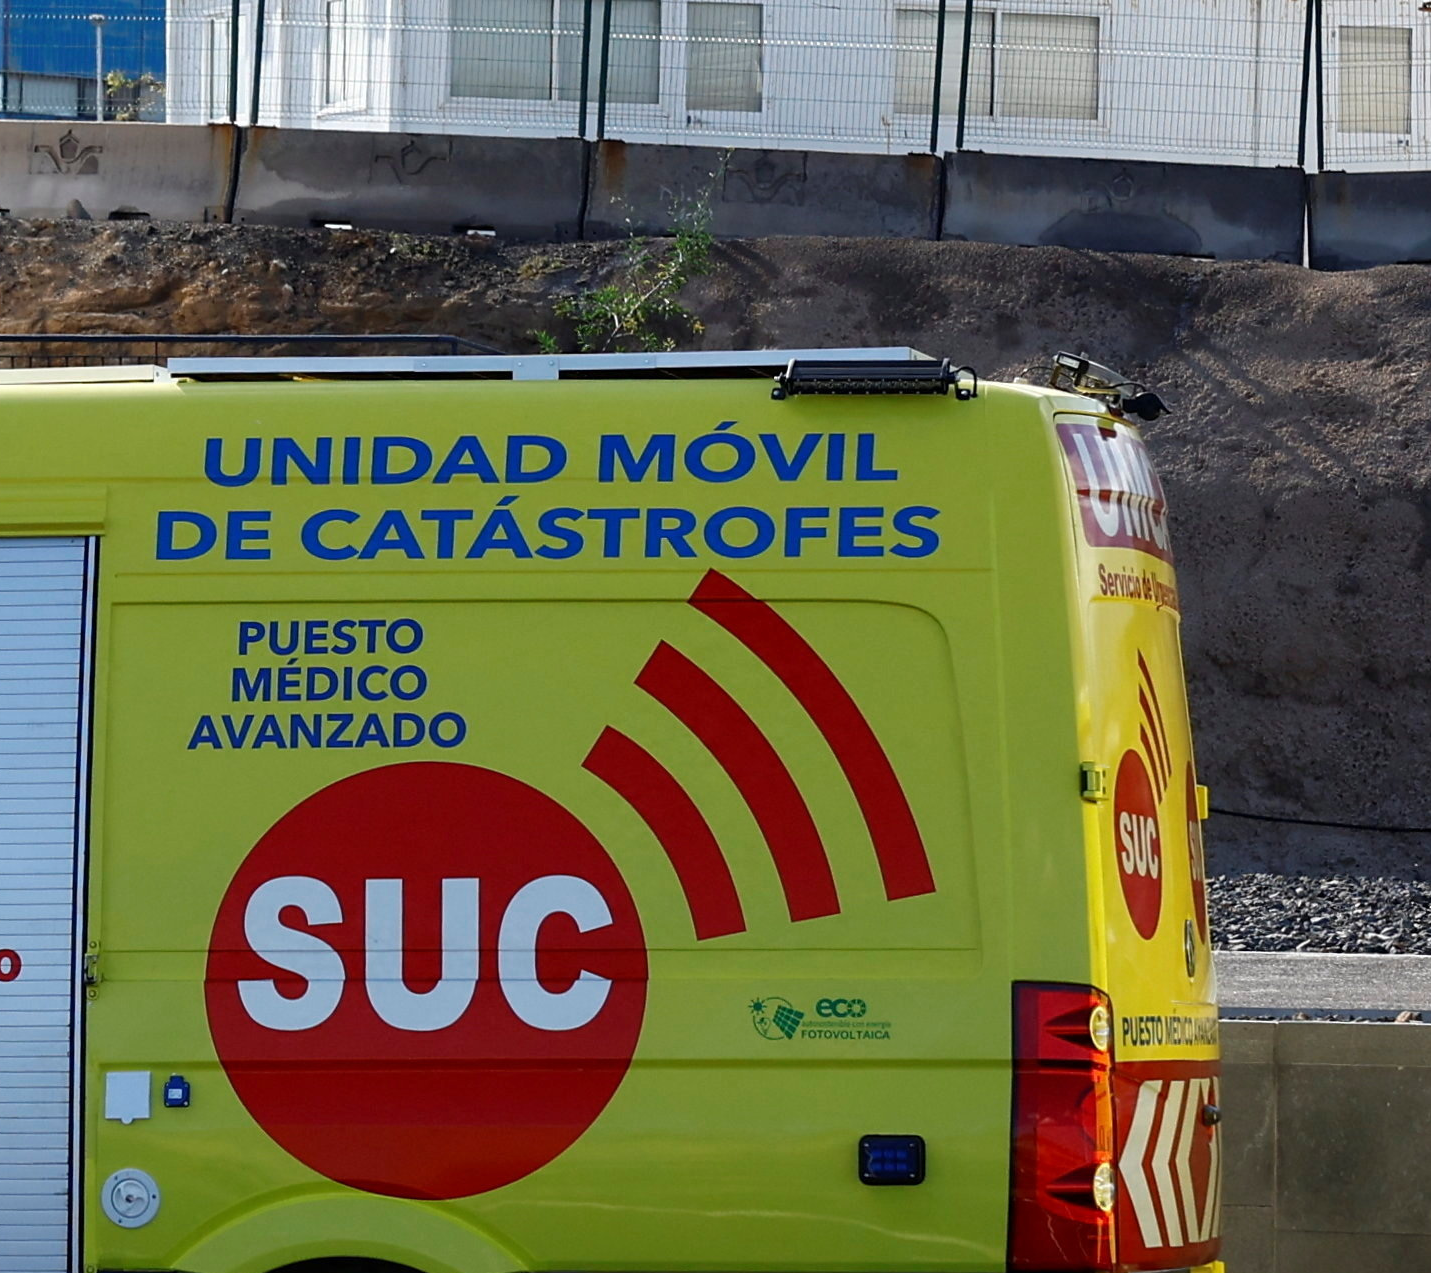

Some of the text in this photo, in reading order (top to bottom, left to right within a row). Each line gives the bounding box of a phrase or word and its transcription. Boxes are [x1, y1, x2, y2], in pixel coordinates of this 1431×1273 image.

[205, 420, 899, 487] UNIDAD MÓVIL
[156, 495, 940, 561] DE CATÁSTROFES
[1098, 564, 1142, 599] Servicio
[239, 618, 424, 656] PUESTO
[231, 658, 429, 702] MÉDICO
[189, 711, 467, 749] AVANZADO
[1120, 811, 1158, 879] SUC
[237, 875, 613, 1031] SUC
[816, 998, 867, 1018] eco
[1122, 1016, 1163, 1046] PUESTO
[1165, 1008, 1193, 1046] MÉDICO
[801, 1029, 891, 1040] FOTOVOLTAICA
